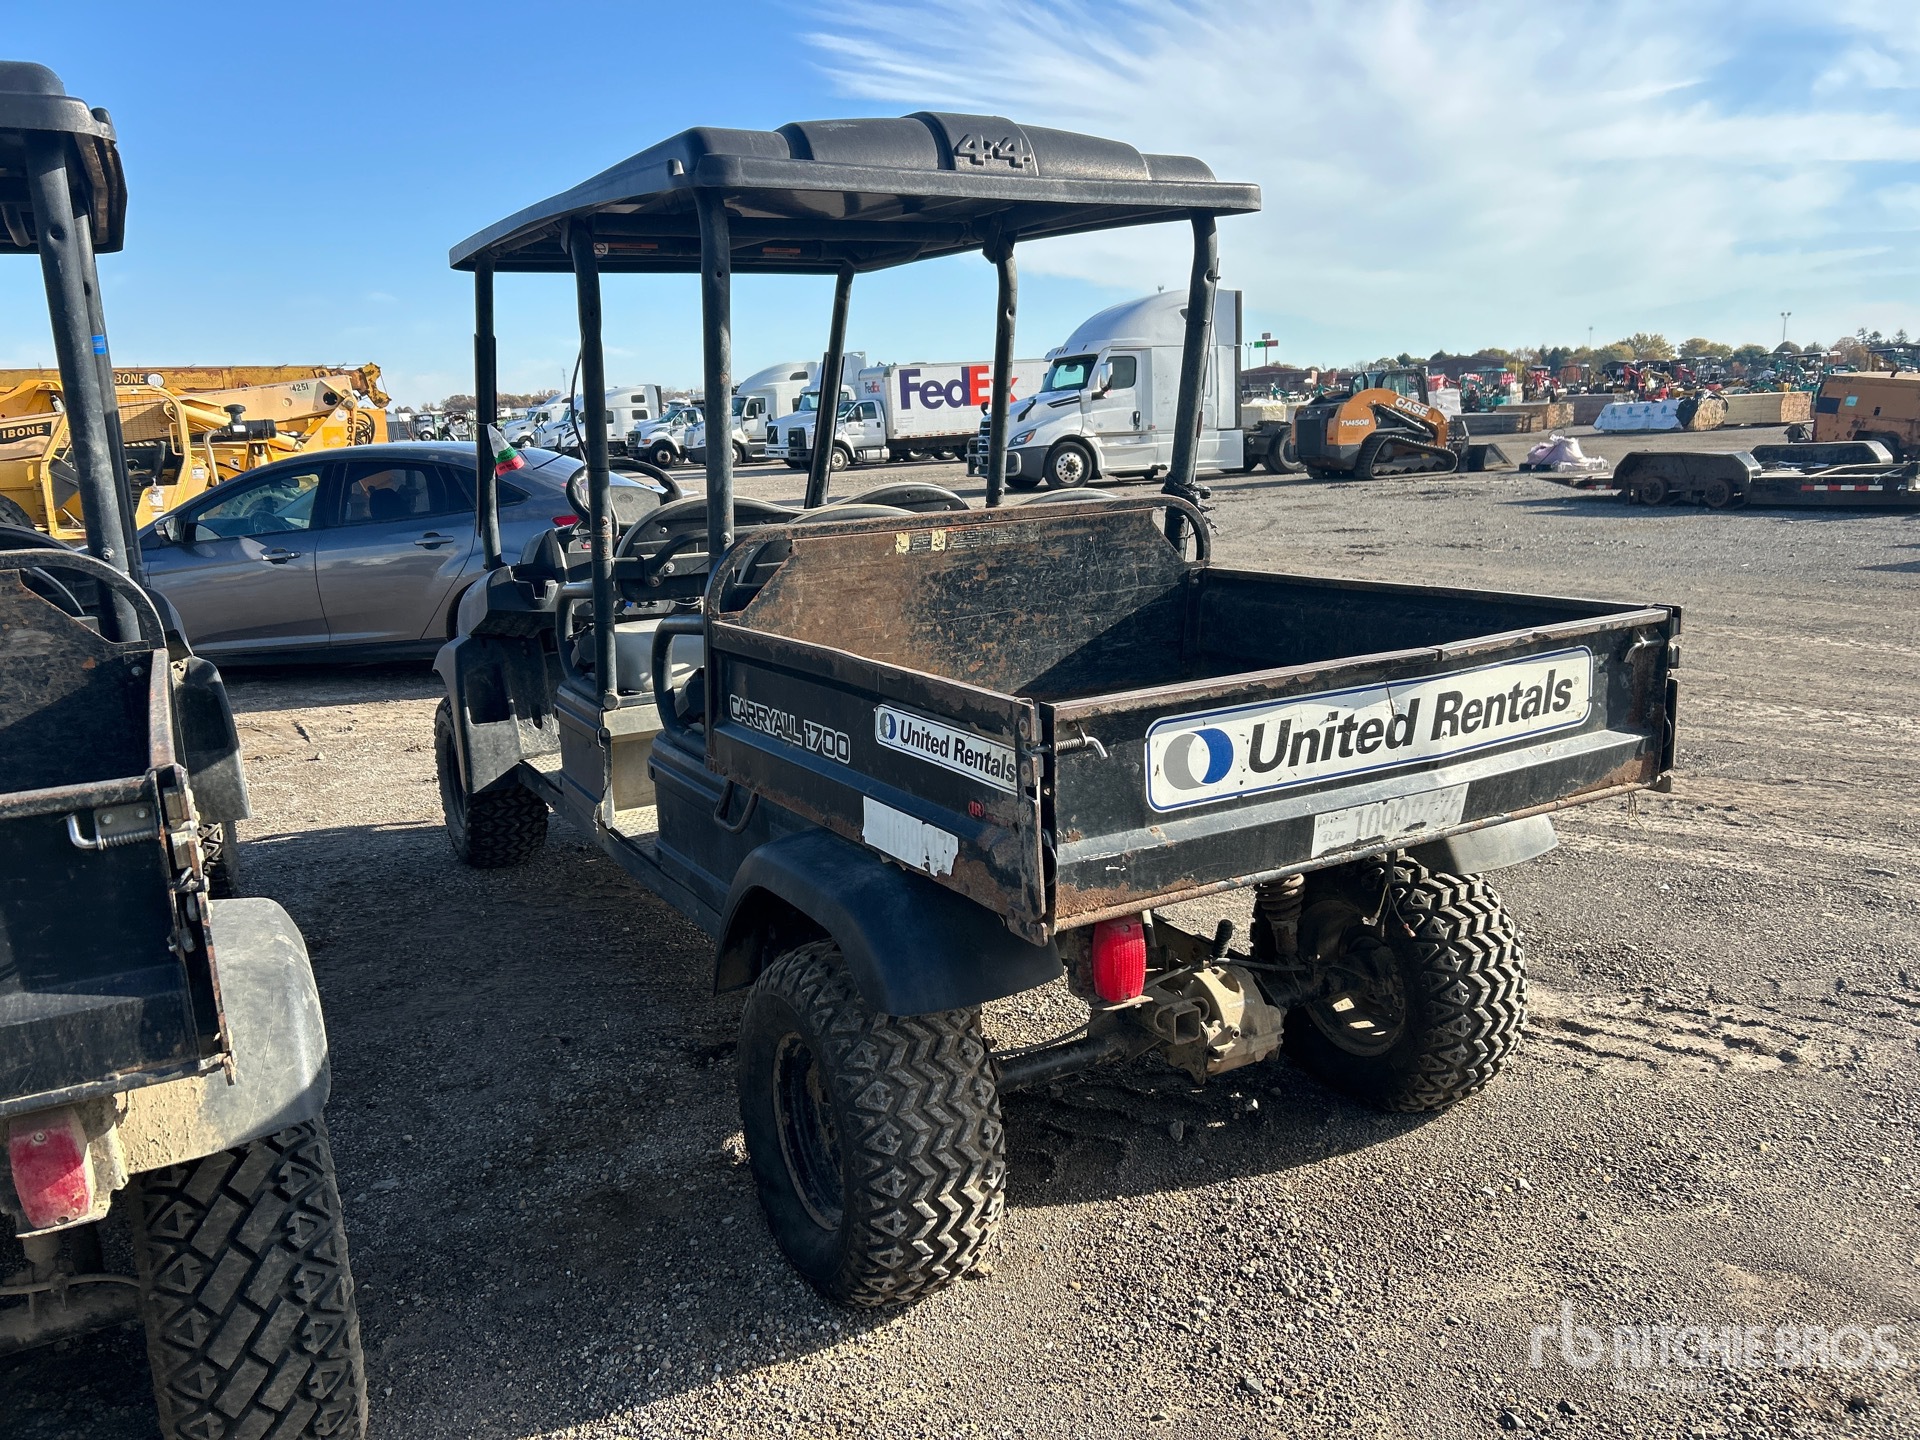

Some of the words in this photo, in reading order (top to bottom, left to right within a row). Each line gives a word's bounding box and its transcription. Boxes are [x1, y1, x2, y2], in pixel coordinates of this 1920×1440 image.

[1395, 397, 1429, 418] CASE
[729, 694, 803, 746] CARRYALL
[803, 719, 851, 764] 1700
[900, 719, 950, 759] United
[953, 737, 1016, 783] Rentals
[1249, 697, 1421, 774] United
[1430, 669, 1573, 741] Rentals
